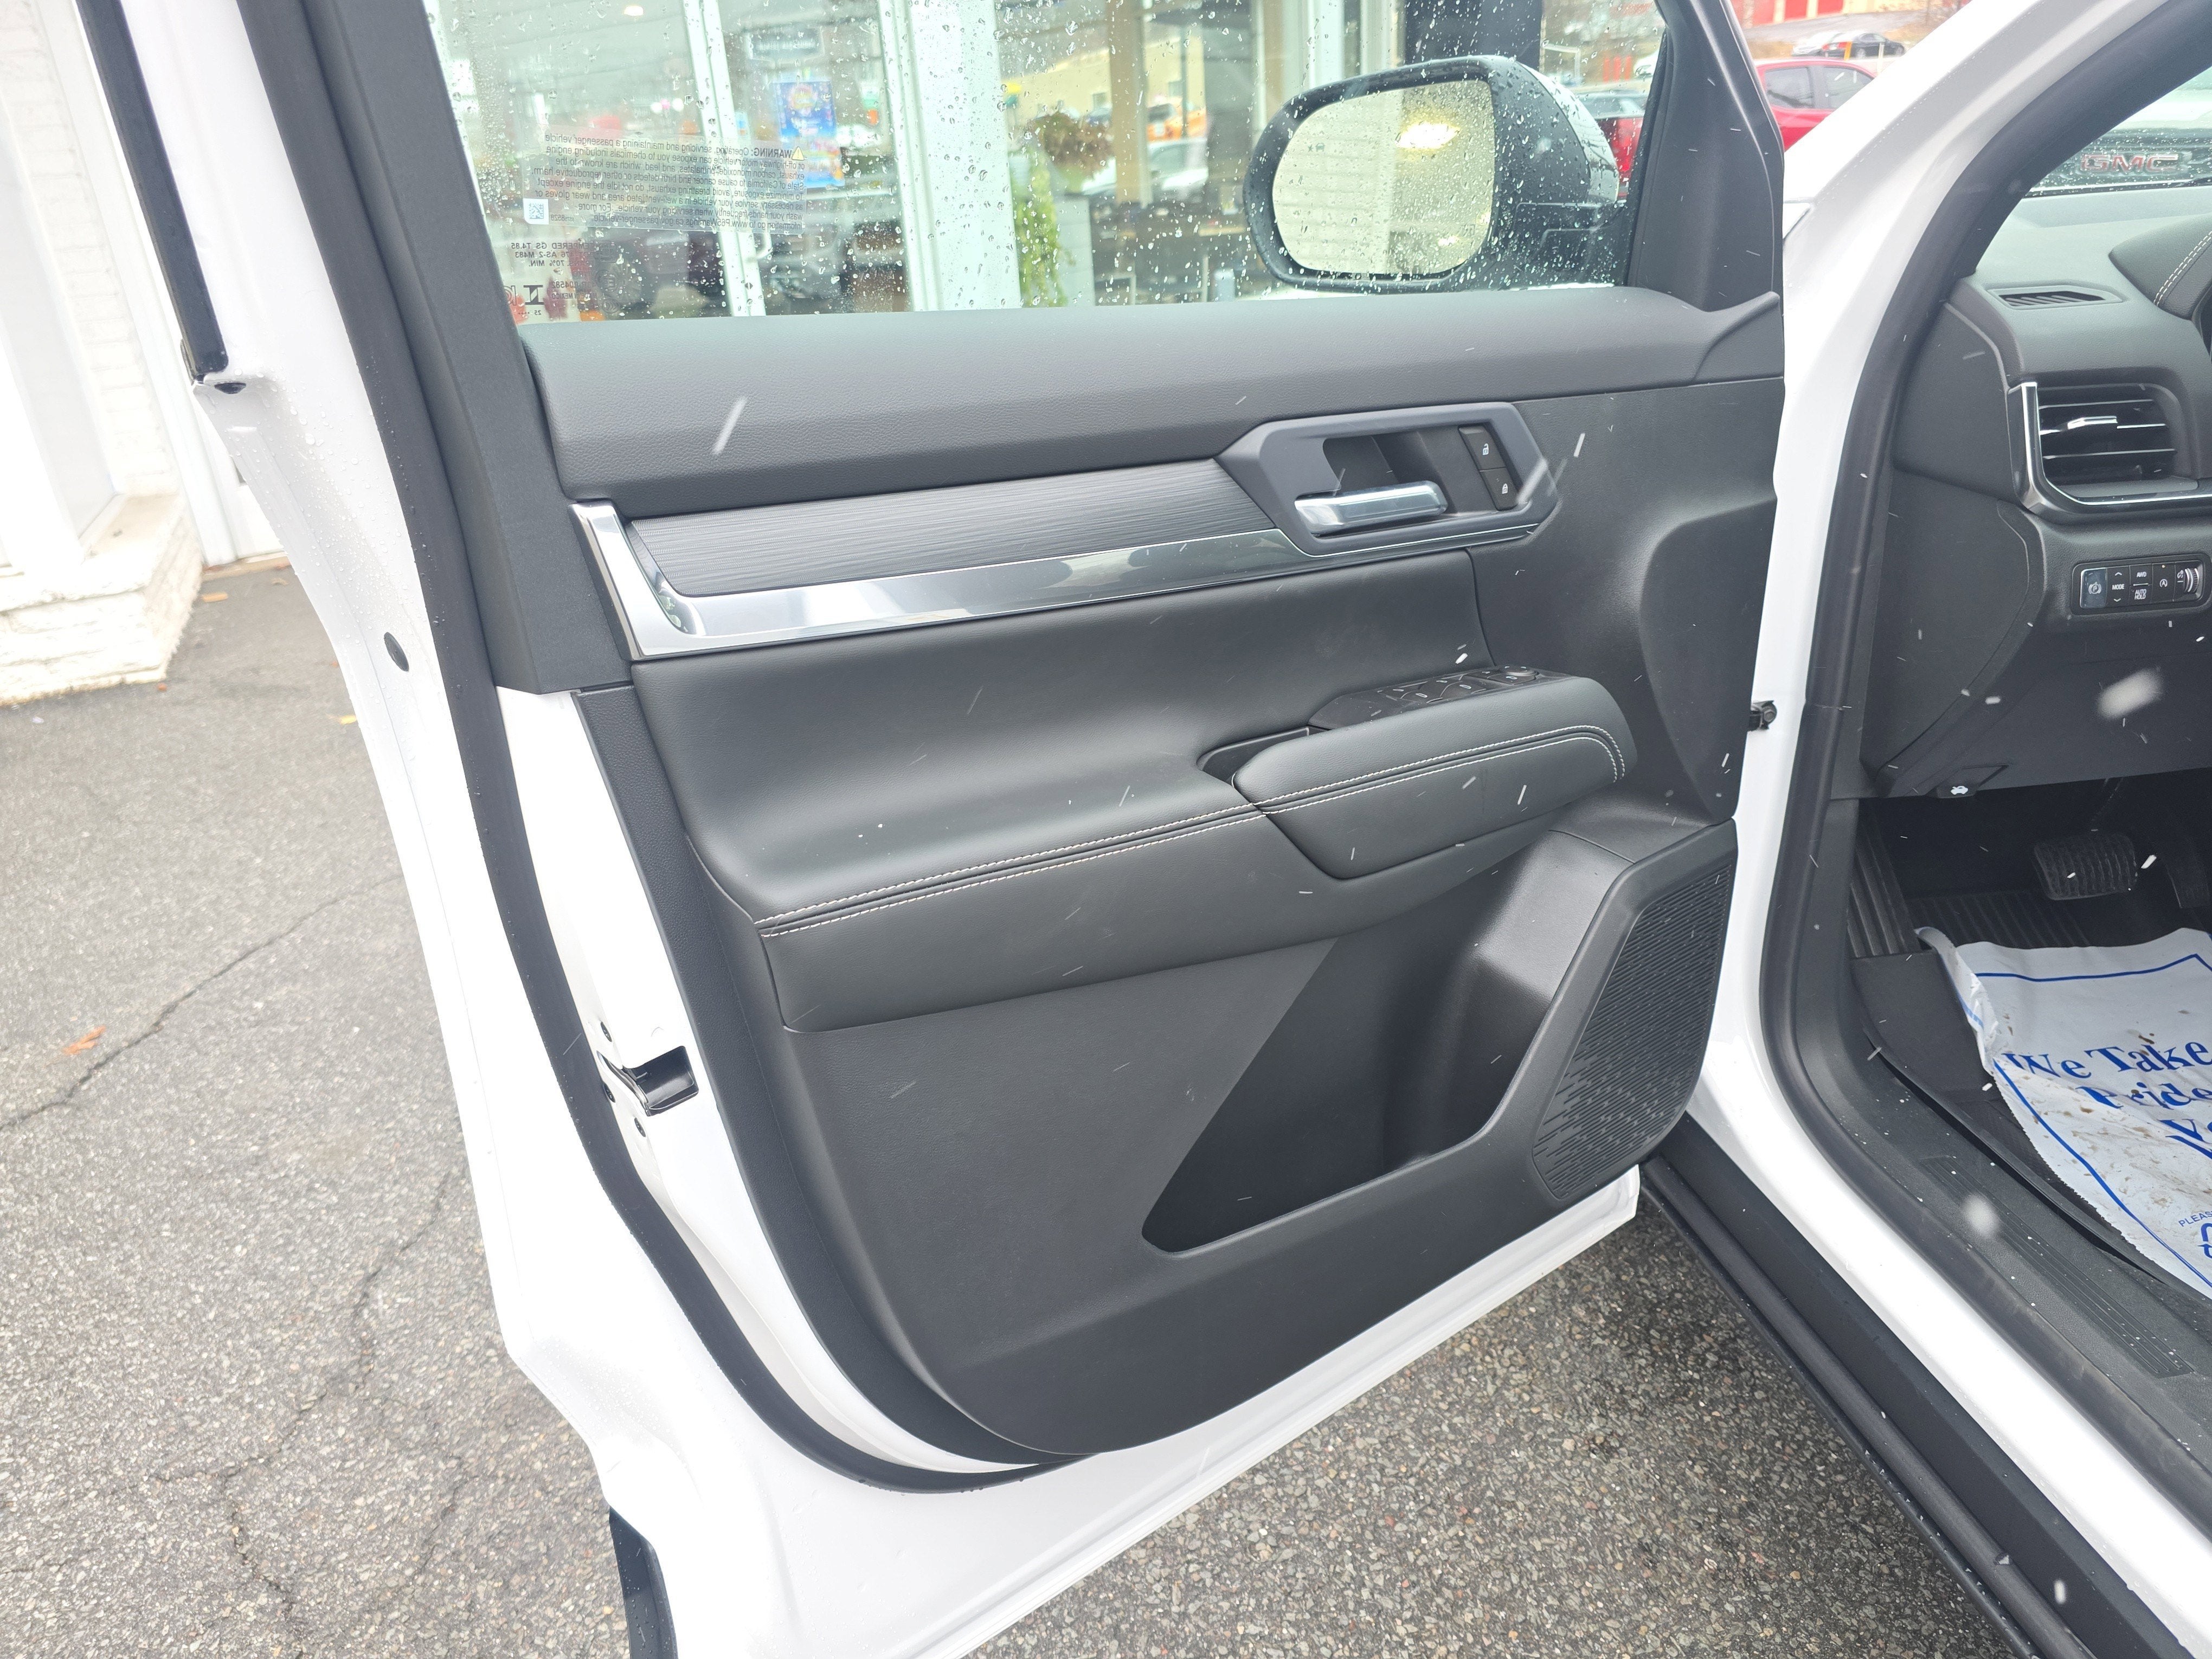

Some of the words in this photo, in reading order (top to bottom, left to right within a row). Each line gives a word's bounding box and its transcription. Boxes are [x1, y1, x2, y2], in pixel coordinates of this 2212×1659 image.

[2081, 153, 2178, 172] GMC
[2001, 1053, 2092, 1078] We
[2084, 1042, 2212, 1072] Take
[2178, 1211, 2212, 1227] PLEAS
